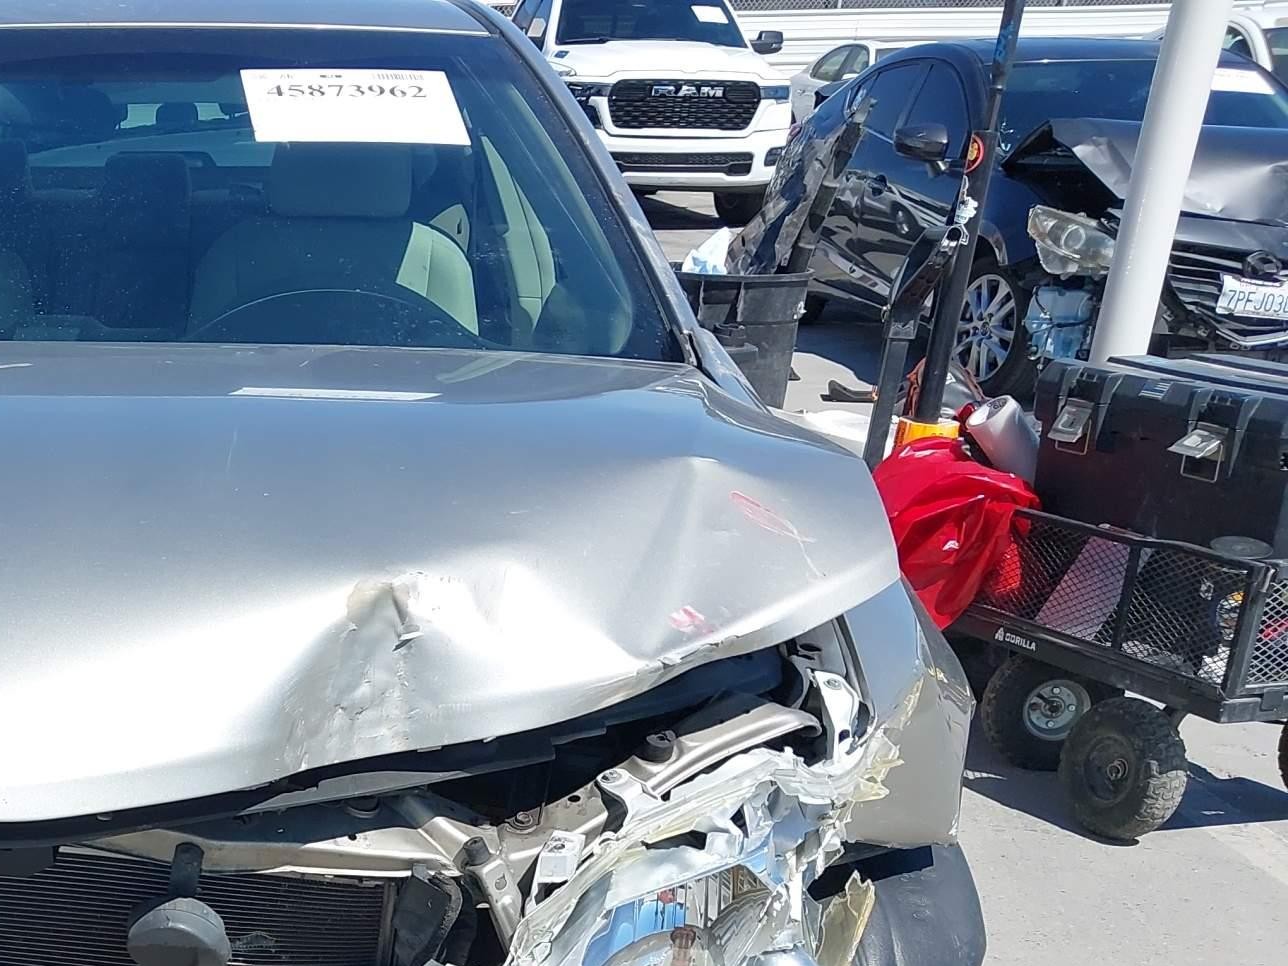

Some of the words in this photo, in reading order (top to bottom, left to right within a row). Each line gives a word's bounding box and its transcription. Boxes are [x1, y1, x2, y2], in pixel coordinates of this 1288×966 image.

[266, 84, 427, 98] 45873962
[652, 85, 724, 97] RAM
[1005, 632, 1036, 651] GORILLA
